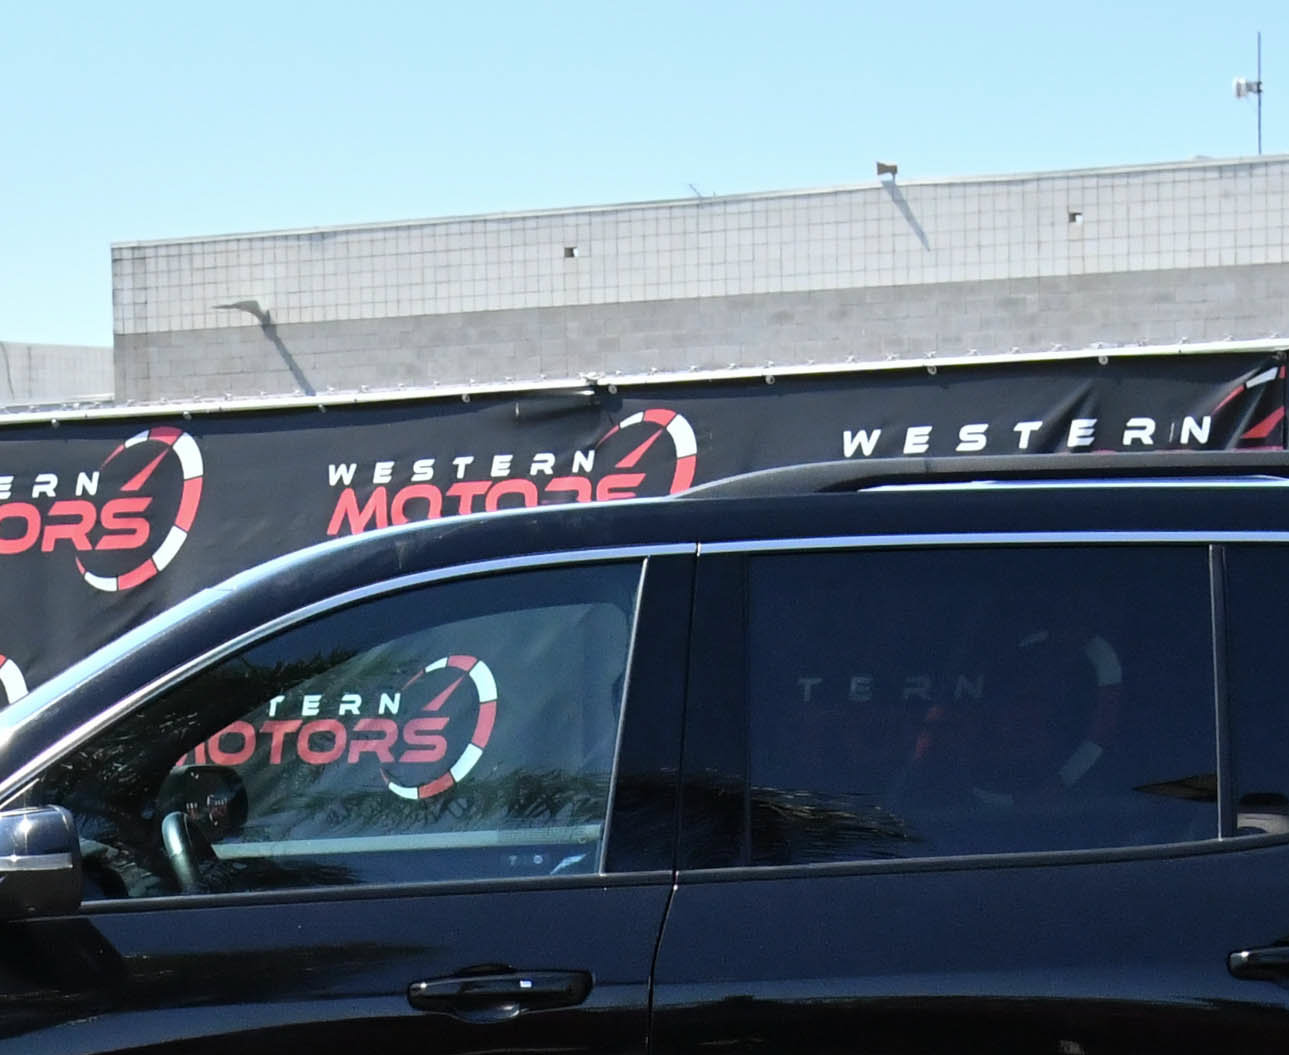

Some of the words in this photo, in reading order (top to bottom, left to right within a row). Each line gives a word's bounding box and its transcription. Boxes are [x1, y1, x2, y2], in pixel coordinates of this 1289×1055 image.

[841, 415, 1212, 458] WESTERN
[328, 449, 596, 487] WESTERN
[268, 691, 402, 717] TERN
[797, 674, 983, 702] TERN
